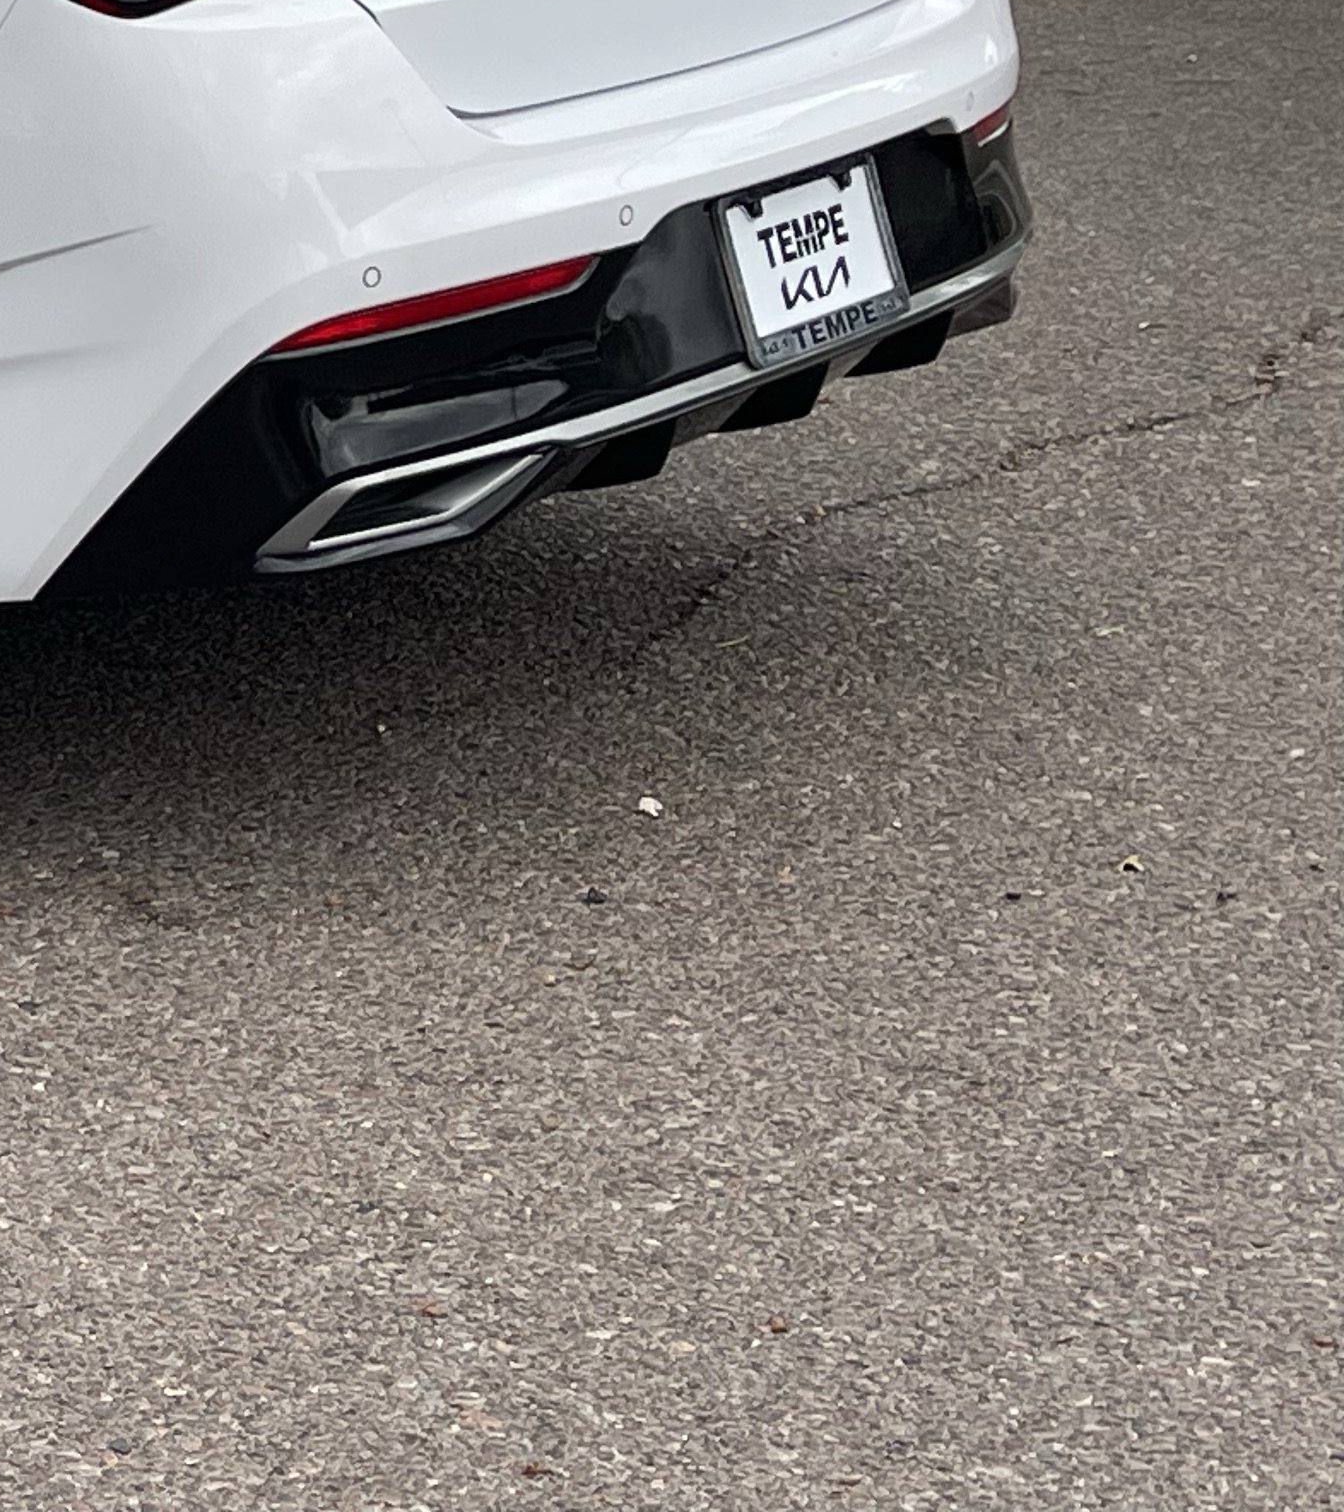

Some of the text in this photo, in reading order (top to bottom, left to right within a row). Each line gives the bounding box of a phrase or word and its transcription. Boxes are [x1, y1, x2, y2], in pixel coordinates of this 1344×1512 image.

[757, 203, 849, 268] TEMPE
[781, 256, 850, 309] KIA
[792, 300, 878, 349] TEMPE
